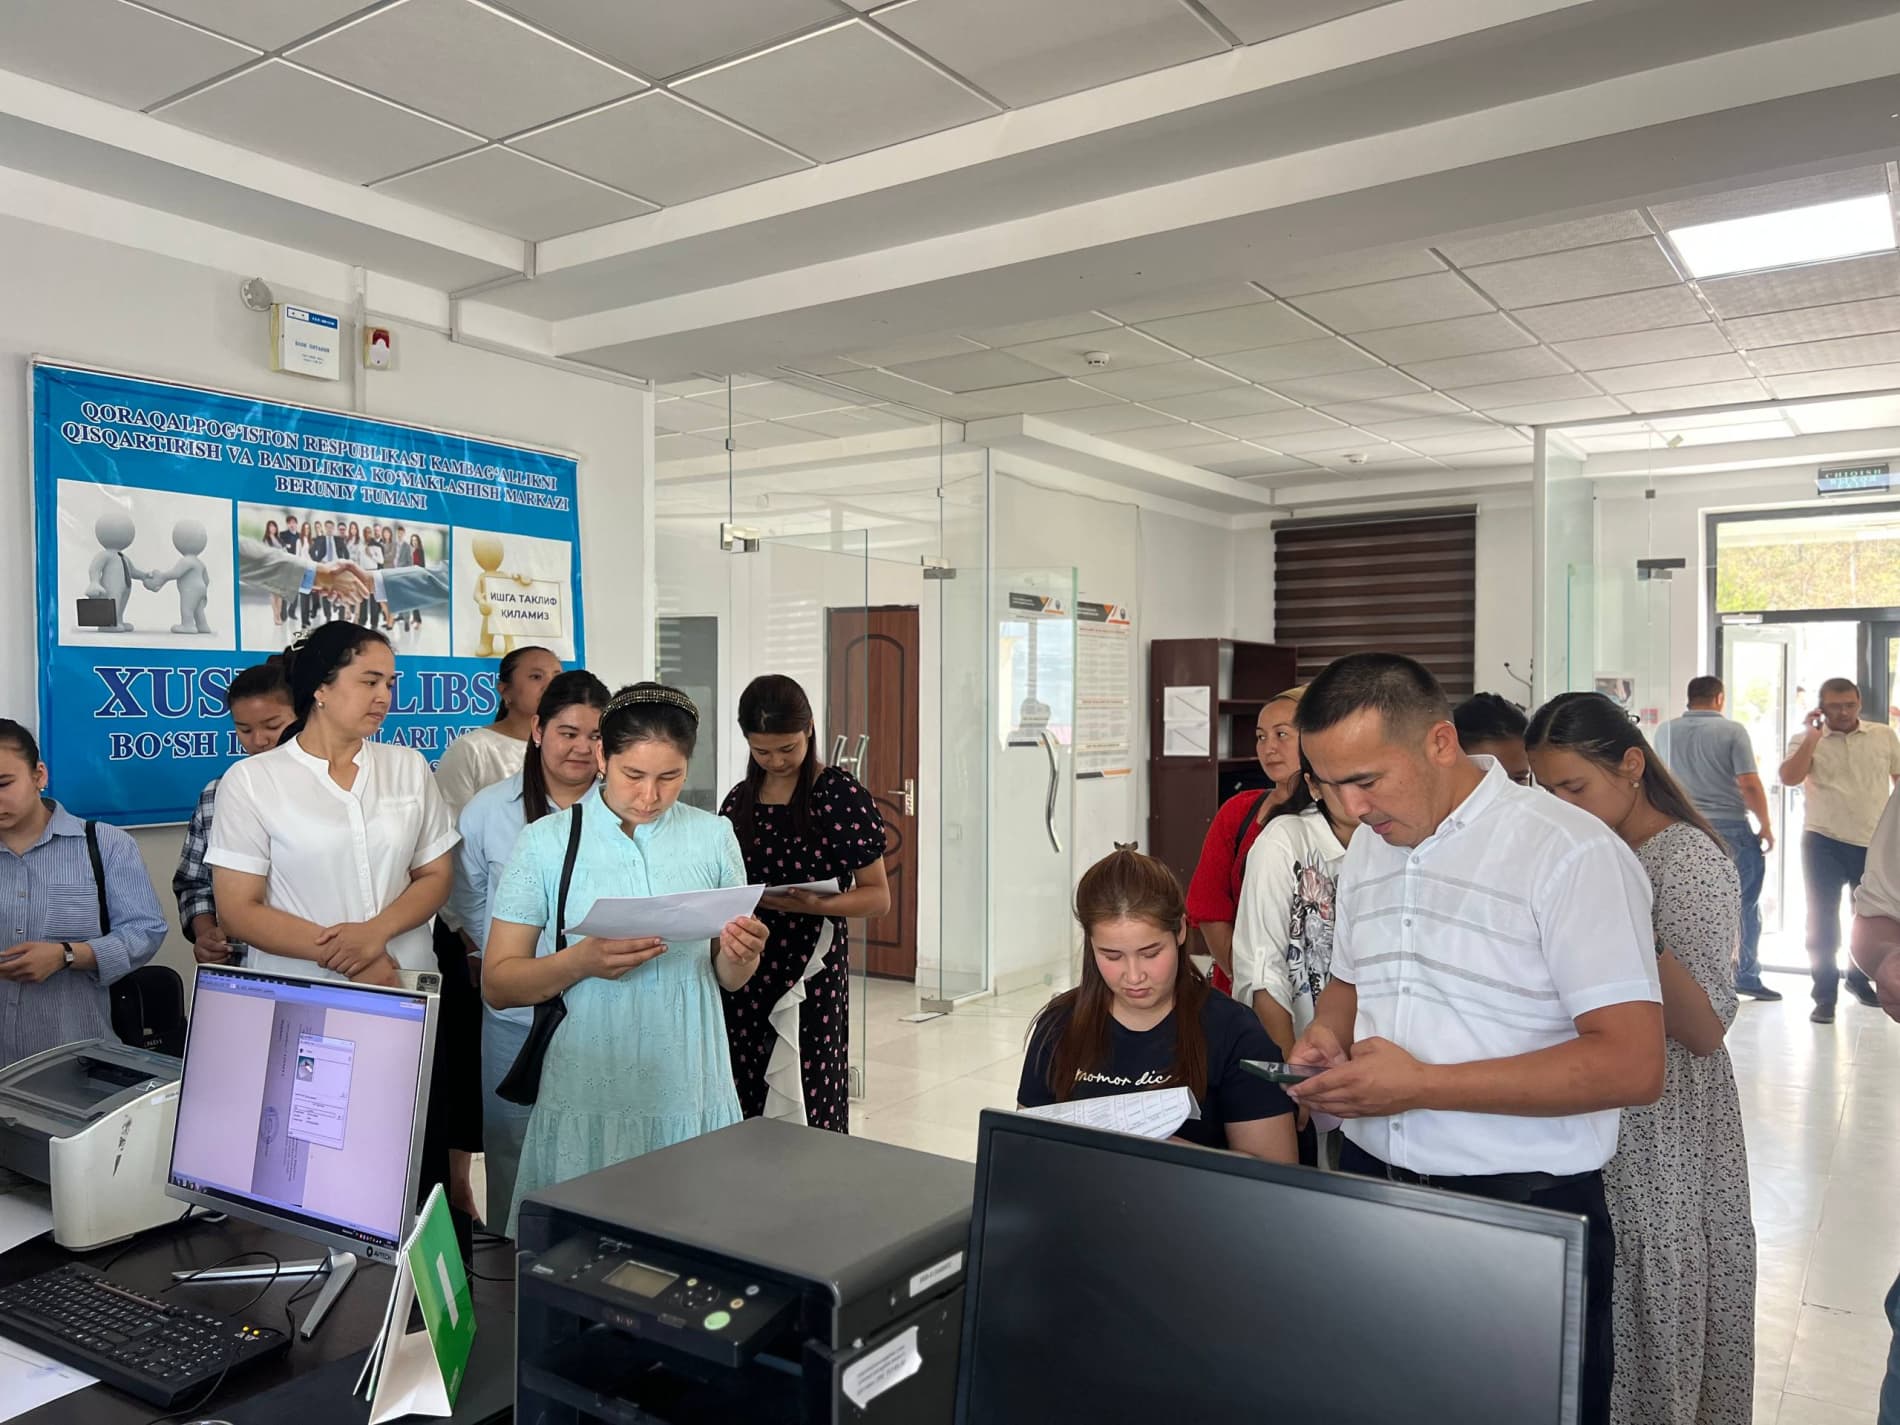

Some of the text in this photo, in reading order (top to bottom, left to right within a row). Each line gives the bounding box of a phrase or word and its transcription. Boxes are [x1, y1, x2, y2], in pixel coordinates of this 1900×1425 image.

[61, 421, 222, 461] QISQARTIRISH
[226, 446, 253, 466] VA
[258, 451, 367, 480] BANDLIKKA
[504, 487, 570, 512] MARKAZI
[304, 434, 427, 470] RESPUBLIKASI
[275, 475, 428, 511] BERUNIY TUMANI
[490, 591, 558, 606] ИШГА ТАКЛИФ
[93, 666, 500, 718] XUS LIBS
[109, 731, 218, 761] BO‘SH
[366, 726, 438, 750] LARI
